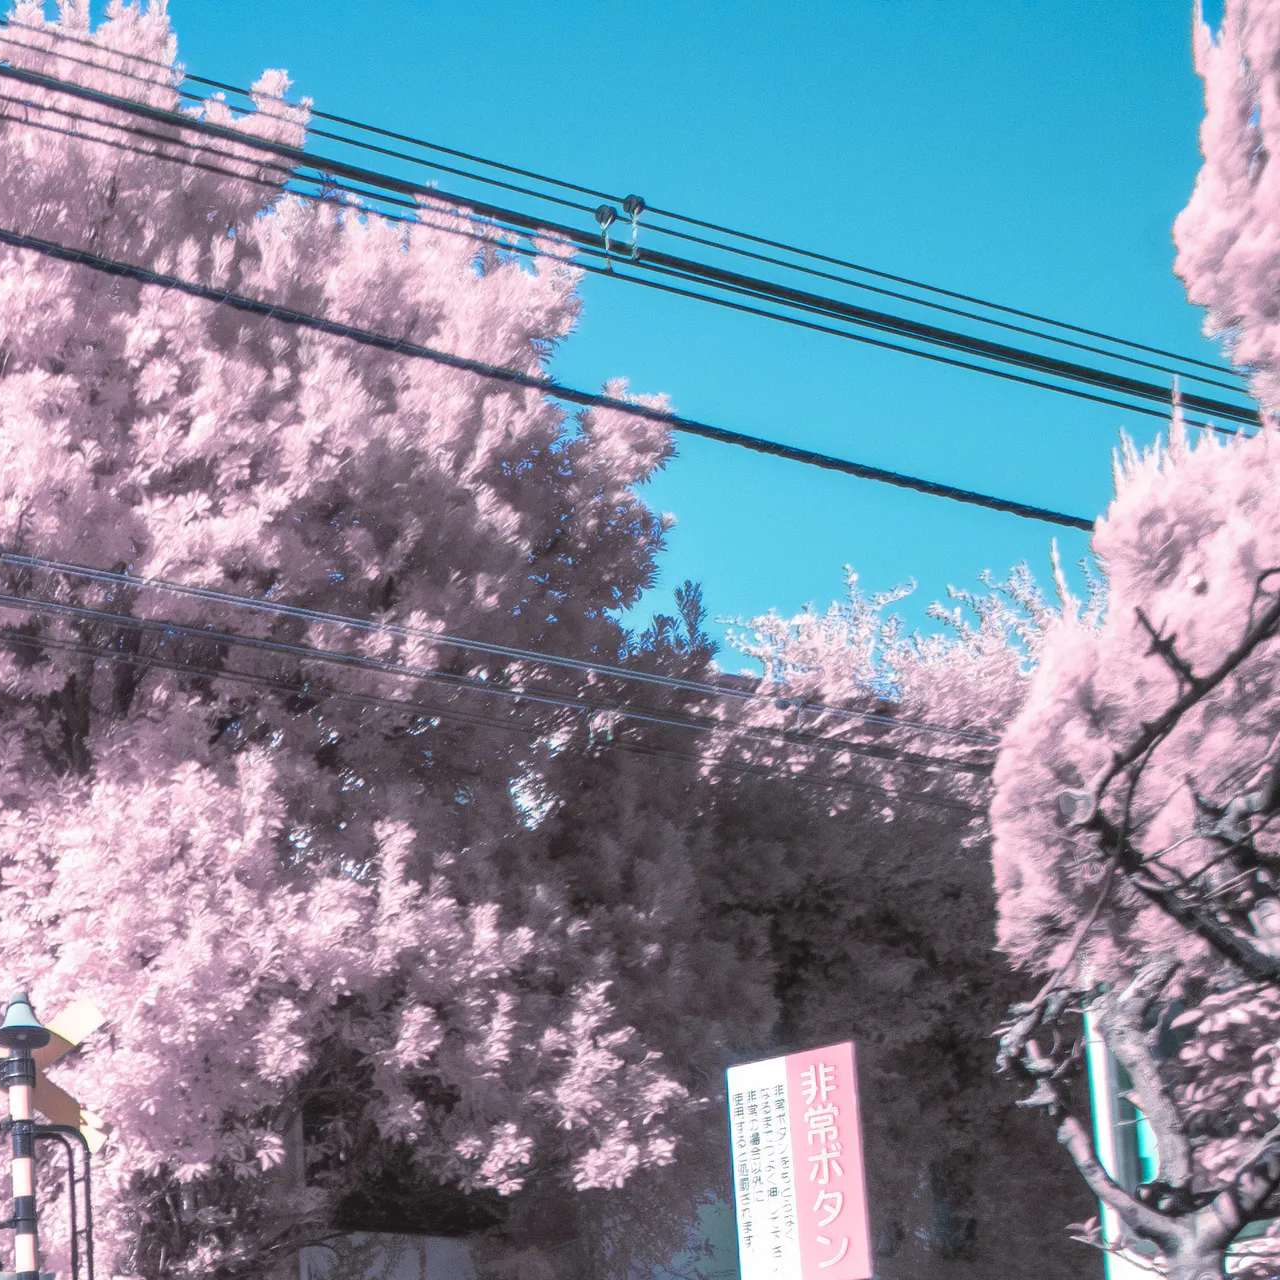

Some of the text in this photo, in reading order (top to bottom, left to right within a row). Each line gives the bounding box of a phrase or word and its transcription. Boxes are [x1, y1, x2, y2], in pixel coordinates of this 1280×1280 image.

[799, 1062, 850, 1269] 非常ボタン
